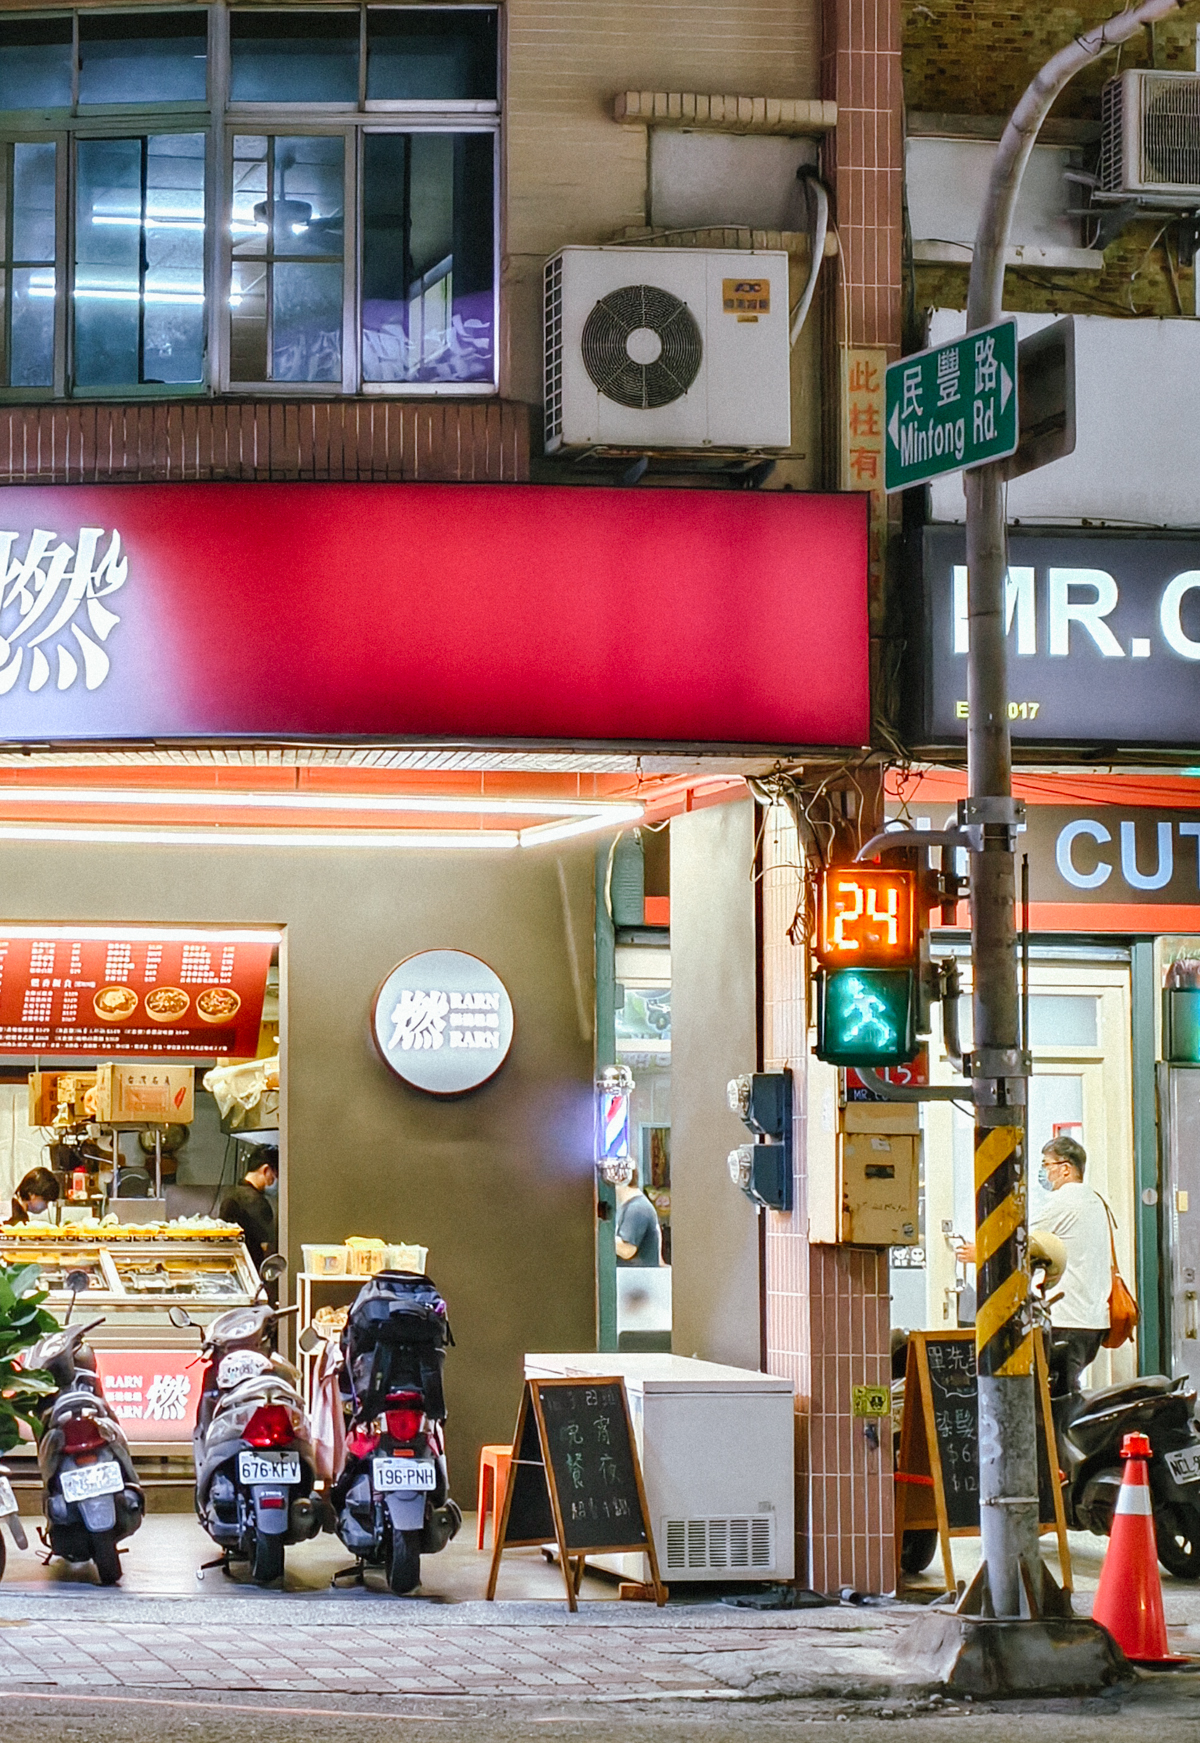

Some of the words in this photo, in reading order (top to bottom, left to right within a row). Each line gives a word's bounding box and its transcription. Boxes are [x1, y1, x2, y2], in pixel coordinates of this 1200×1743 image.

[901, 335, 999, 420] 民豐路
[900, 417, 965, 467] Minfong
[973, 396, 998, 445] Rd.
[834, 882, 898, 950] 24
[110, 1405, 143, 1419] ARN
